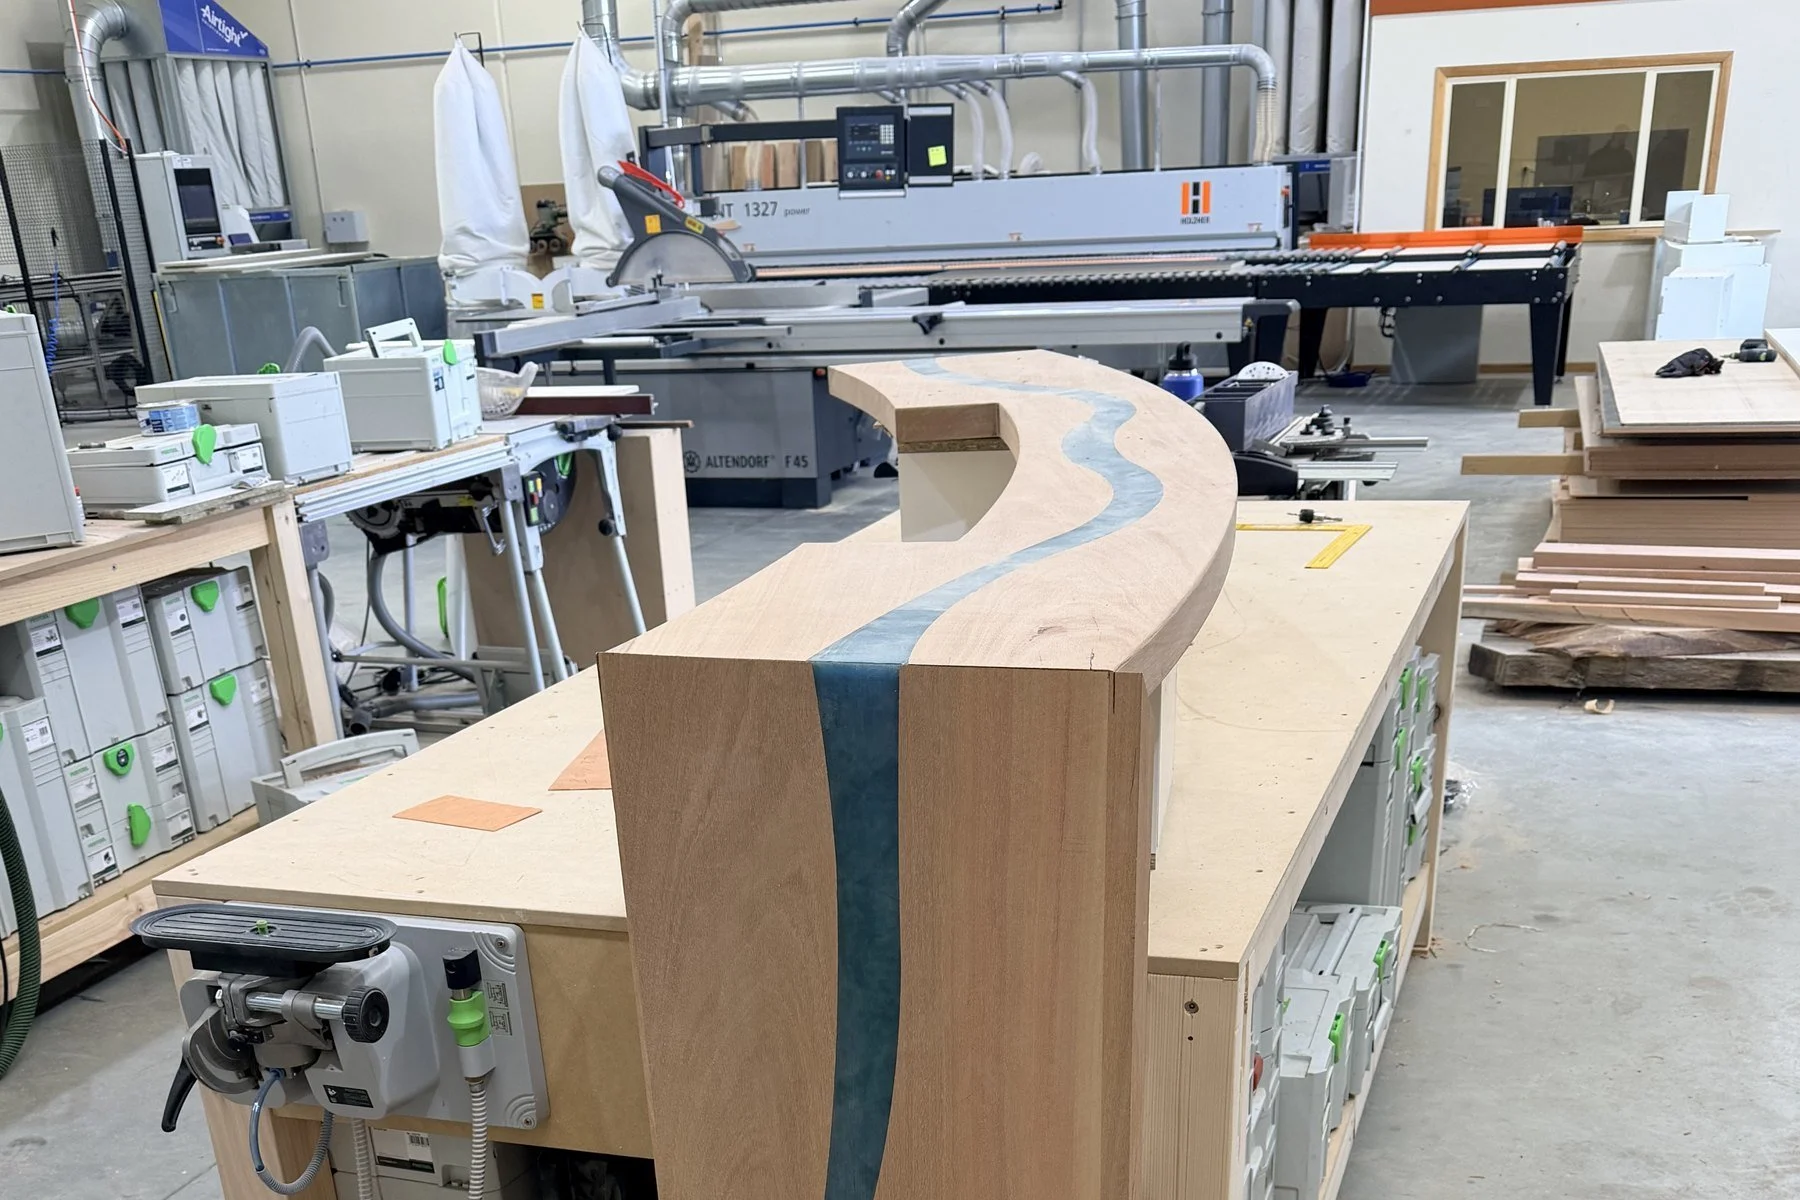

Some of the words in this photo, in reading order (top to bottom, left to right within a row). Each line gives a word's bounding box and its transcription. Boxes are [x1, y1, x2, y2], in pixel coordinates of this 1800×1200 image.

[202, 5, 241, 47] Airtight
[744, 201, 778, 217] 1327
[705, 455, 770, 468] ALTENDORF
